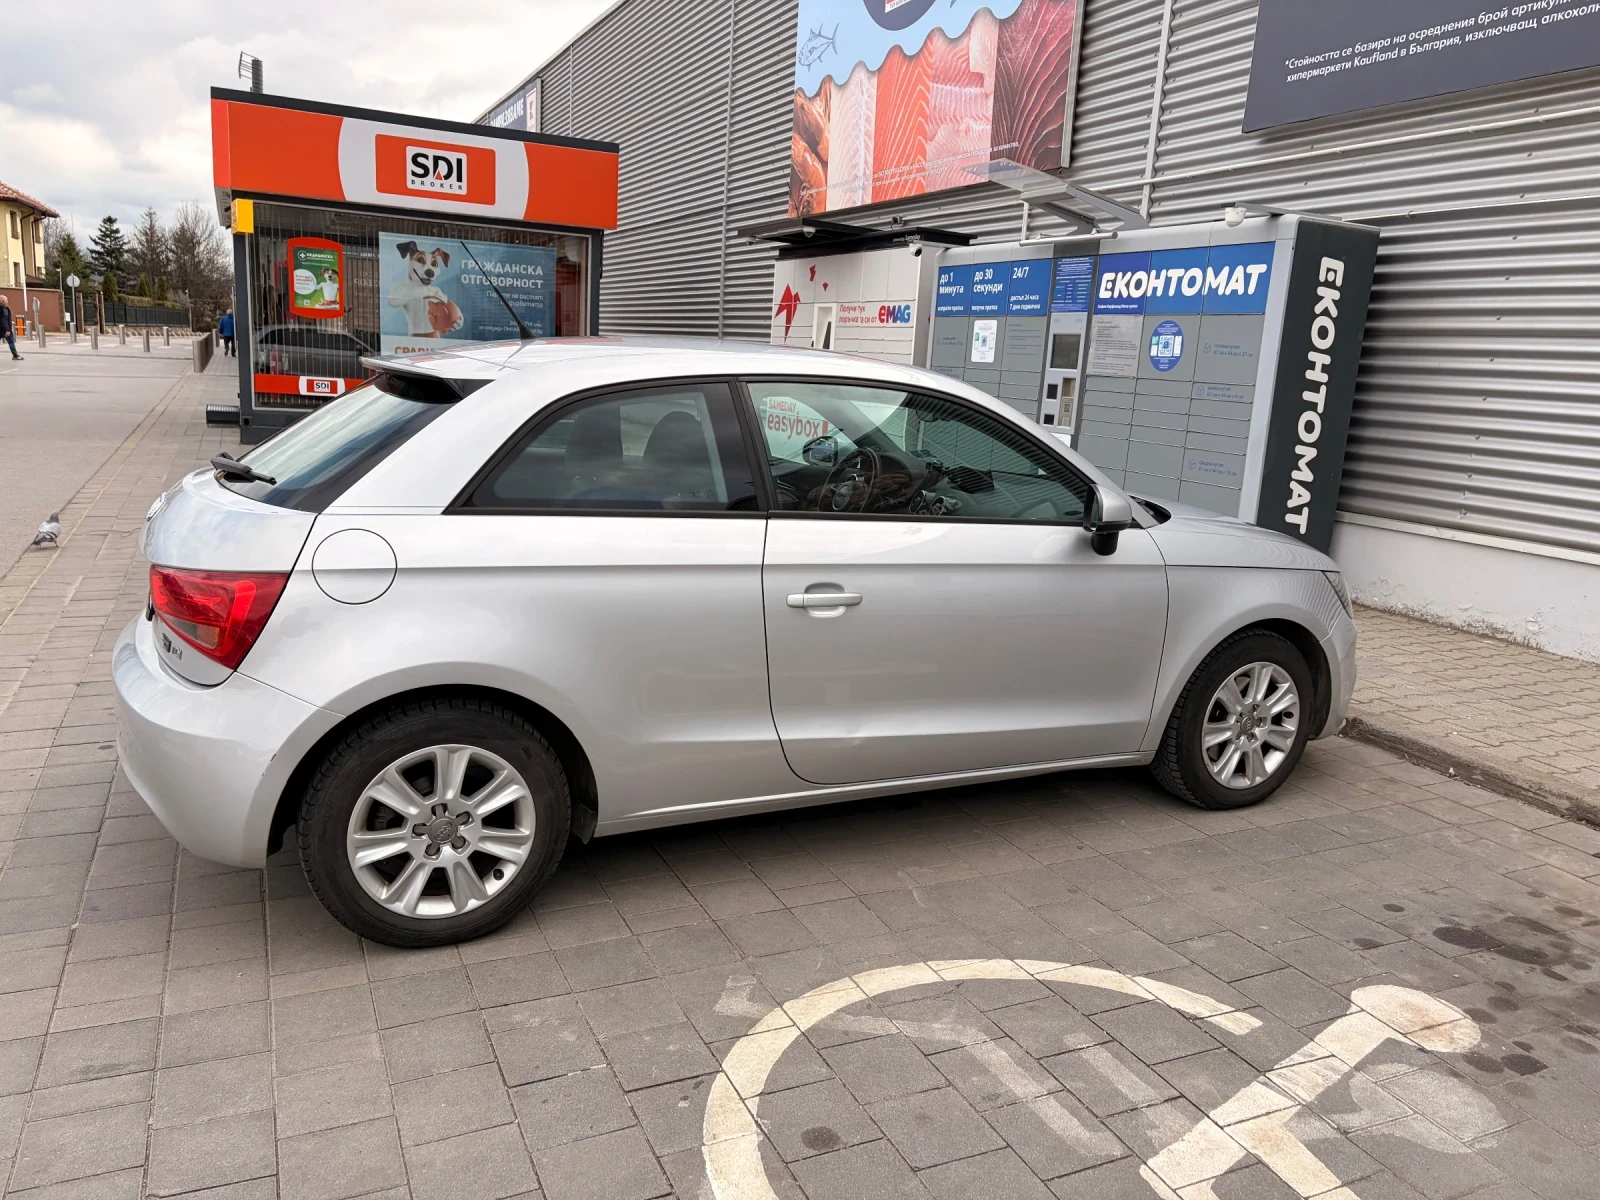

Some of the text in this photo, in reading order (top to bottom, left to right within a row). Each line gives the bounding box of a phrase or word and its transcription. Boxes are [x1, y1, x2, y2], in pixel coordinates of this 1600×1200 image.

[1341, 47, 1353, 57] се
[1354, 37, 1391, 54] базира
[1392, 33, 1407, 45] на
[1408, 17, 1475, 41] осреднения
[1477, 7, 1509, 26] брой
[1286, 60, 1352, 83] хипермаркети
[1353, 47, 1399, 68] Kaufland
[1400, 48, 1407, 57] в
[1409, 36, 1463, 55] България,
[1465, 18, 1538, 43] изключващ
[411, 152, 463, 183] SDI
[411, 179, 463, 191] BROKER
[461, 259, 544, 276] ГРАЖДАНСКА
[1012, 266, 1030, 279] 24/7
[461, 274, 544, 289] ОТГОВОРНОСТ
[940, 271, 954, 285] до 1
[974, 268, 994, 283] до 30
[1098, 263, 1268, 300] ЕКОНТОМАТ
[939, 285, 964, 296] минута
[973, 283, 1003, 295] секунди
[878, 304, 911, 323] eMAG
[315, 381, 330, 390] SDI
[1284, 256, 1345, 535] ЕКОНТОМАТ
[768, 399, 797, 414] SAMEDAY
[767, 411, 820, 440] easybox
